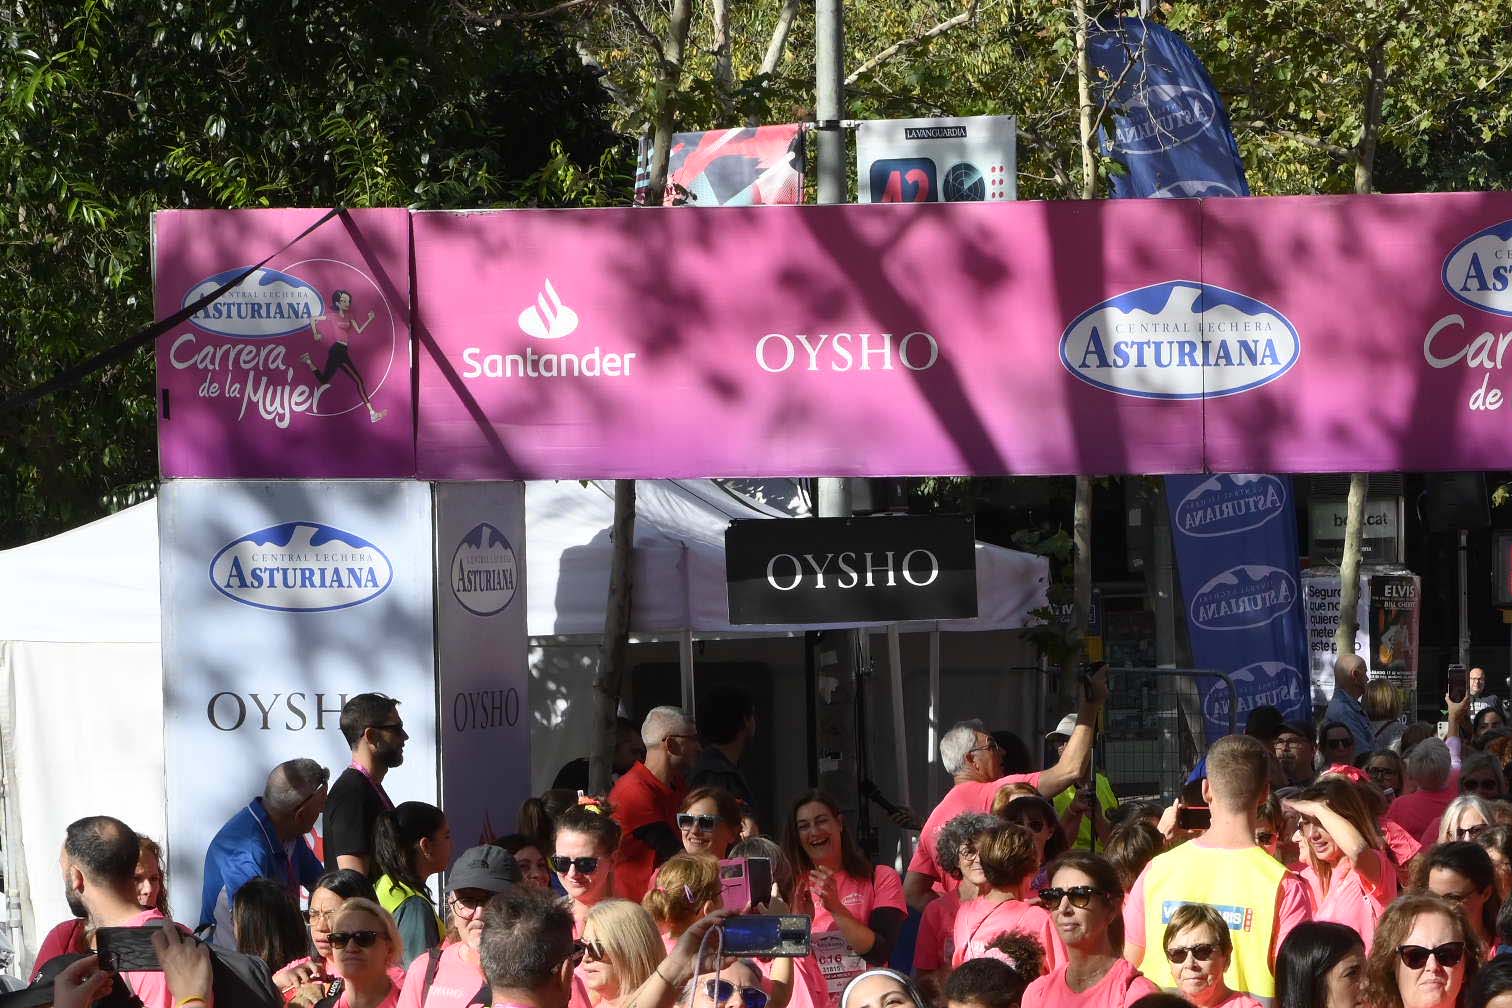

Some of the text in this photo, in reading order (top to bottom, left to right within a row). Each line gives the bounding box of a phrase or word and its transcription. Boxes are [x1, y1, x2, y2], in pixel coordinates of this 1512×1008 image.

[1115, 320, 1273, 334] CENTRAL LECHERA
[169, 333, 286, 370] Carrera
[463, 346, 636, 379] Santander
[755, 332, 938, 373] OYSHO
[1078, 325, 1281, 369] ASTURIANA
[198, 367, 332, 429] de la Mujer
[1469, 372, 1503, 410] de
[224, 555, 380, 590] ASTURIANA
[251, 551, 373, 563] CENTRAL LECHERA
[456, 557, 514, 593] ASTURIANA
[767, 549, 939, 591] OYSHO
[1384, 585, 1415, 597] ELVIS
[207, 691, 380, 732] OYSH
[454, 687, 519, 732] OYSHO
